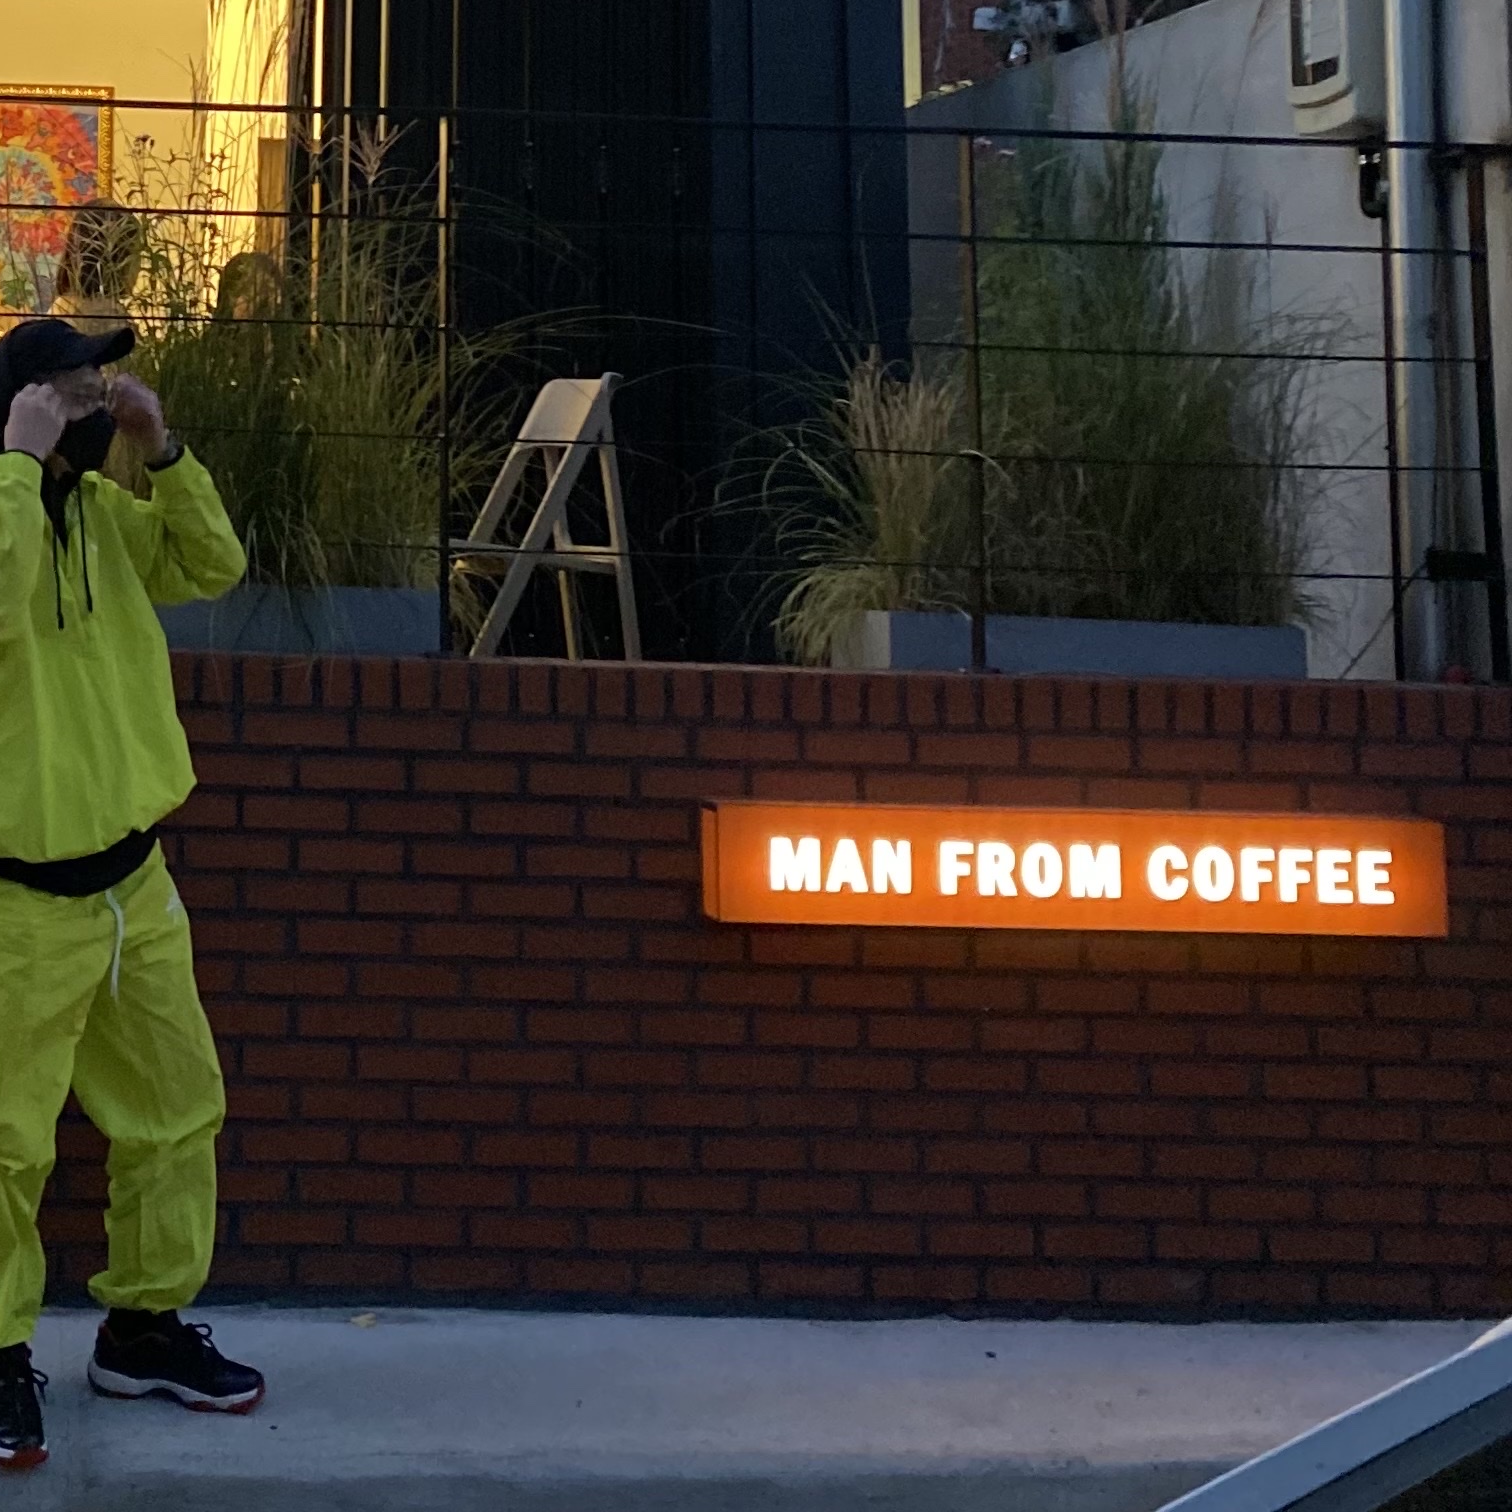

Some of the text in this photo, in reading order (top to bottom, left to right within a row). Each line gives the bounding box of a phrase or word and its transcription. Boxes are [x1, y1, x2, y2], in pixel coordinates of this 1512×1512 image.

[768, 836, 1396, 905] MAN FROM COFFEE
